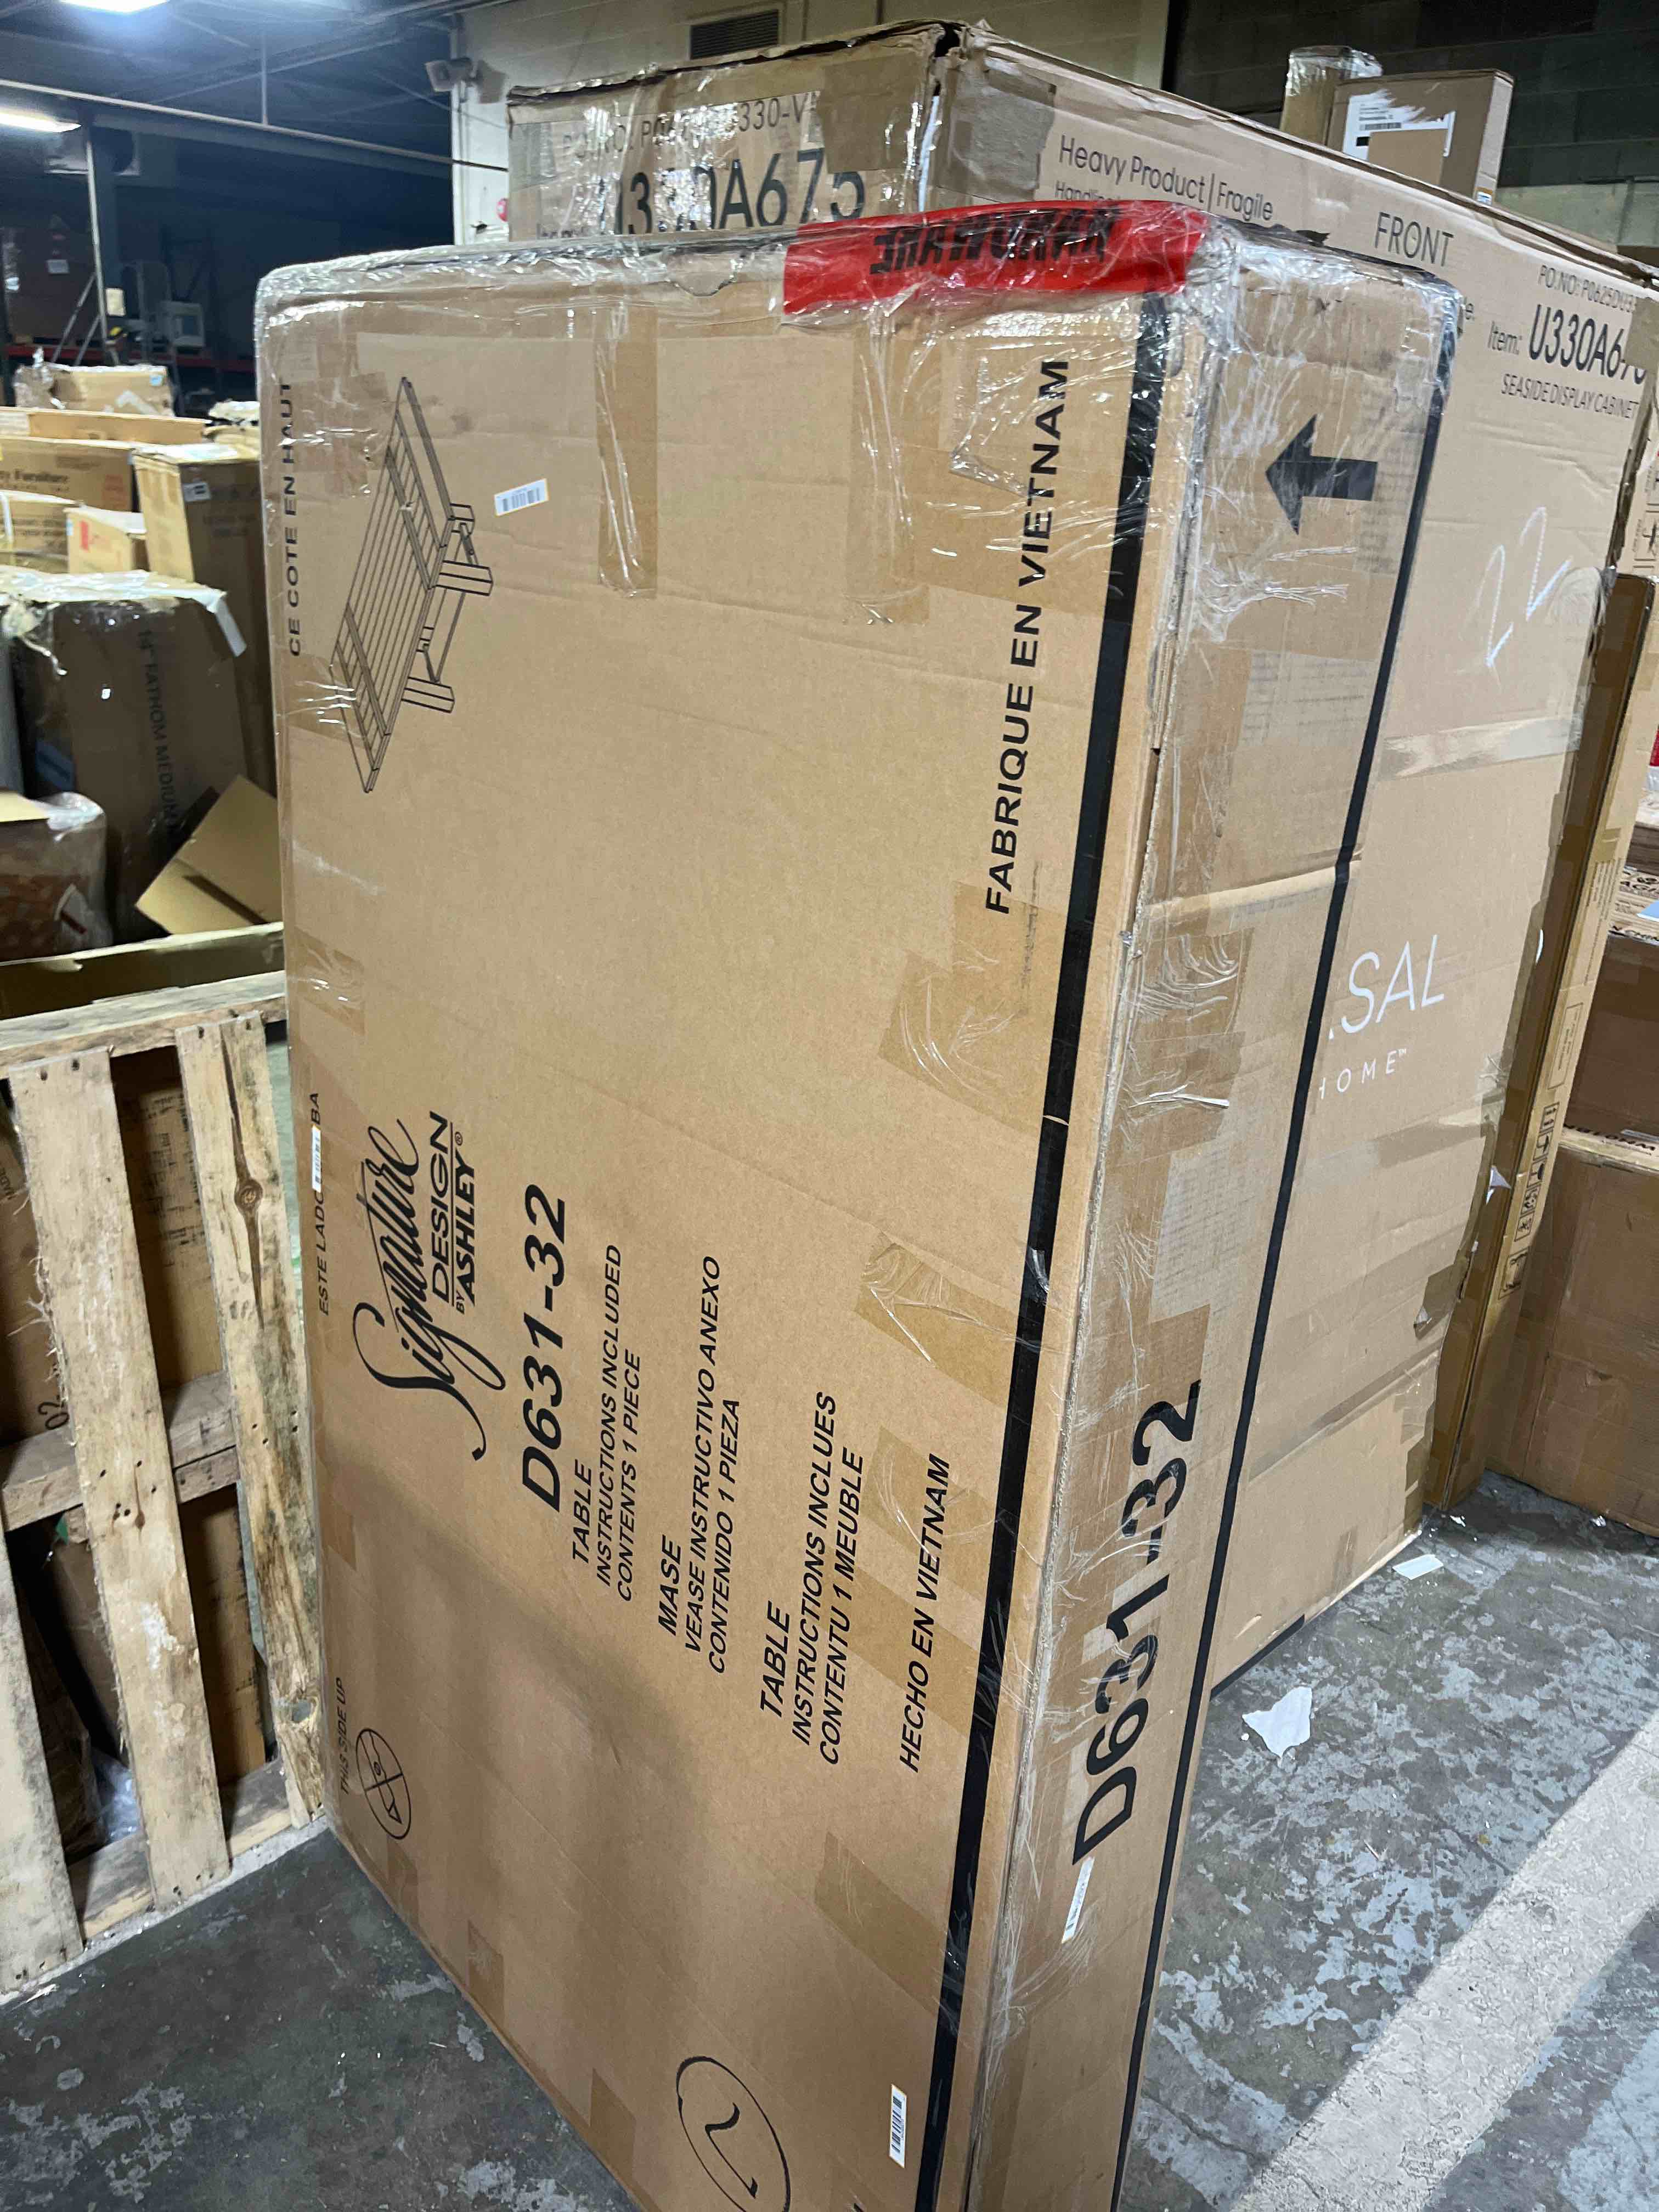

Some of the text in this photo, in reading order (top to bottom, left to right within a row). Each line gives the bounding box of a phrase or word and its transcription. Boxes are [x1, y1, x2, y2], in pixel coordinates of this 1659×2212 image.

[1059, 136, 1273, 222] Heavy Product Fragile
[1374, 212, 1454, 266] FRONT
[1487, 321, 1522, 355] Item:
[1502, 374, 1640, 419] SEASIDE DISPLAY CABINET
[280, 382, 301, 656] CE COTE EN HAUT
[985, 361, 1069, 915] FABRIQUE EN VIETNAM
[317, 1255, 330, 1317] ESTE
[352, 1118, 506, 1461] Signature
[429, 1110, 449, 1304] DESIGN
[455, 1290, 465, 1316] BY
[522, 1183, 566, 1513] D631-32
[596, 1244, 622, 1588] INSTRUCTIONS INCLUDED
[617, 1348, 641, 1602] CONTENTS 1 PIECE
[685, 1255, 720, 1654] VEASE INSTRUCTIVO ANEXO
[572, 1459, 592, 1565] TABLE
[658, 1534, 681, 1637] MASE
[708, 1398, 740, 1674] CONTENIDO 1 PIEZA
[792, 1391, 836, 1746] INSTRUCTIONS INCLUES
[820, 1446, 863, 1765] CONTENTU 1 MEUBLE
[899, 1453, 950, 1773] HECHO EN VIETNAM
[1072, 1379, 1201, 1866] D631-32
[335, 1676, 349, 1795] THIS SIDE UP
[760, 1601, 790, 1719] TABLE
